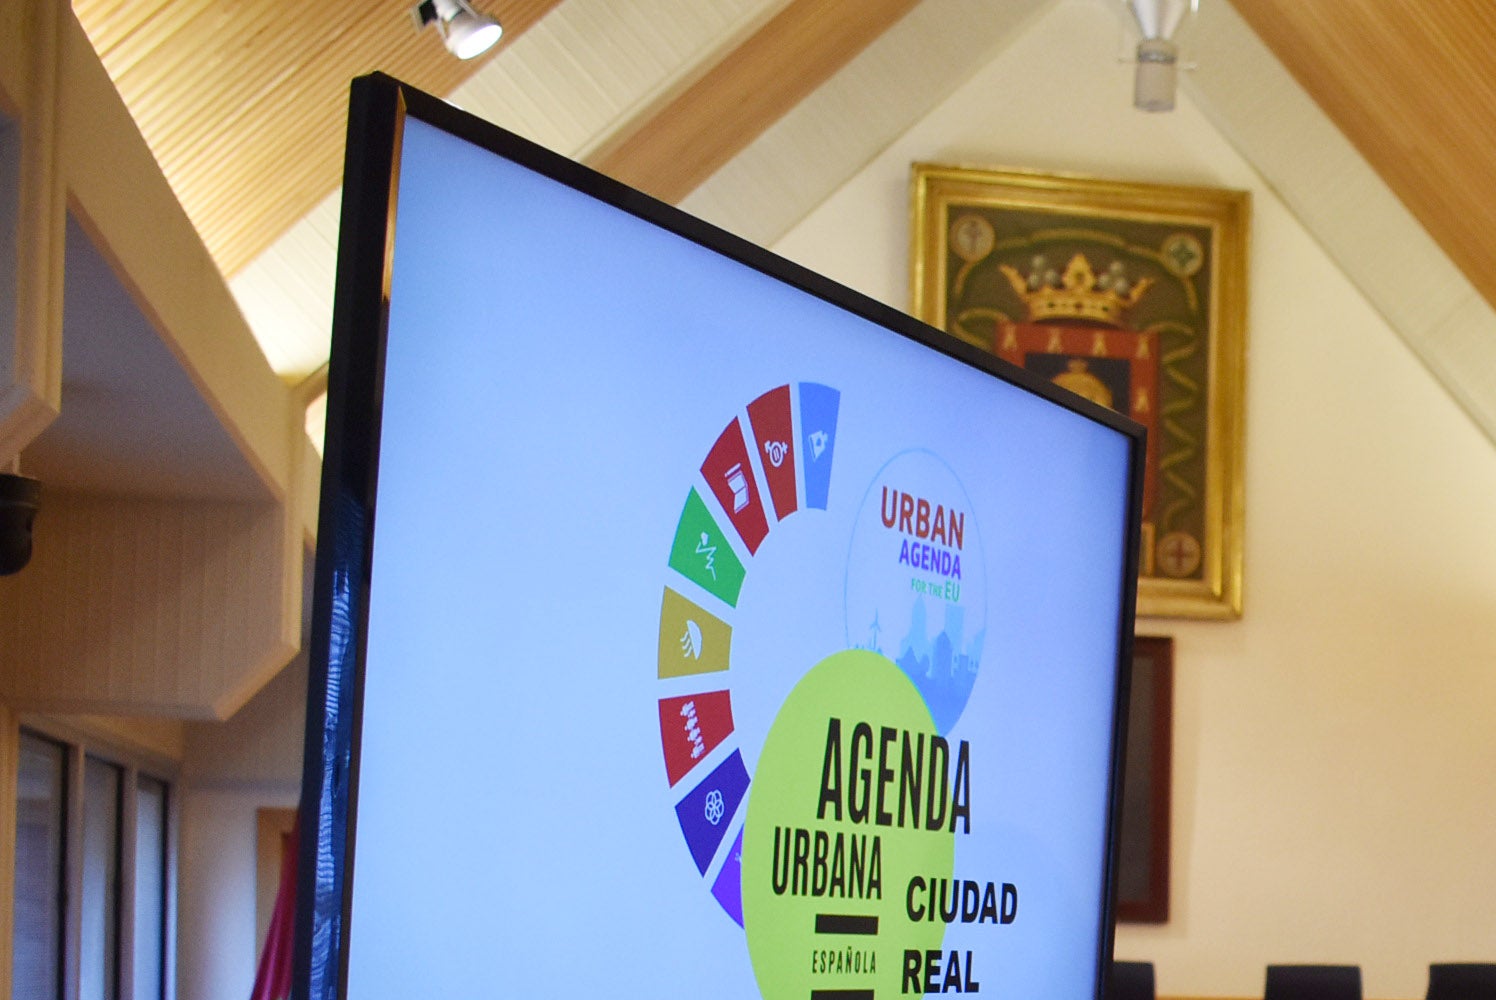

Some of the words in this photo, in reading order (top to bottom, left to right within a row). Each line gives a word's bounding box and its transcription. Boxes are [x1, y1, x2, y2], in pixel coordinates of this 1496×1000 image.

[881, 485, 964, 551] URBAN
[899, 538, 961, 580] AGENDA
[911, 578, 927, 593] FOR
[928, 583, 943, 599] THE
[944, 580, 960, 603] EU
[816, 717, 970, 834] AGENDA
[772, 826, 882, 900] URBANA
[906, 875, 1018, 925] CIUDAD
[812, 946, 876, 974] ESPAÑOLA
[901, 949, 980, 994] REAL
